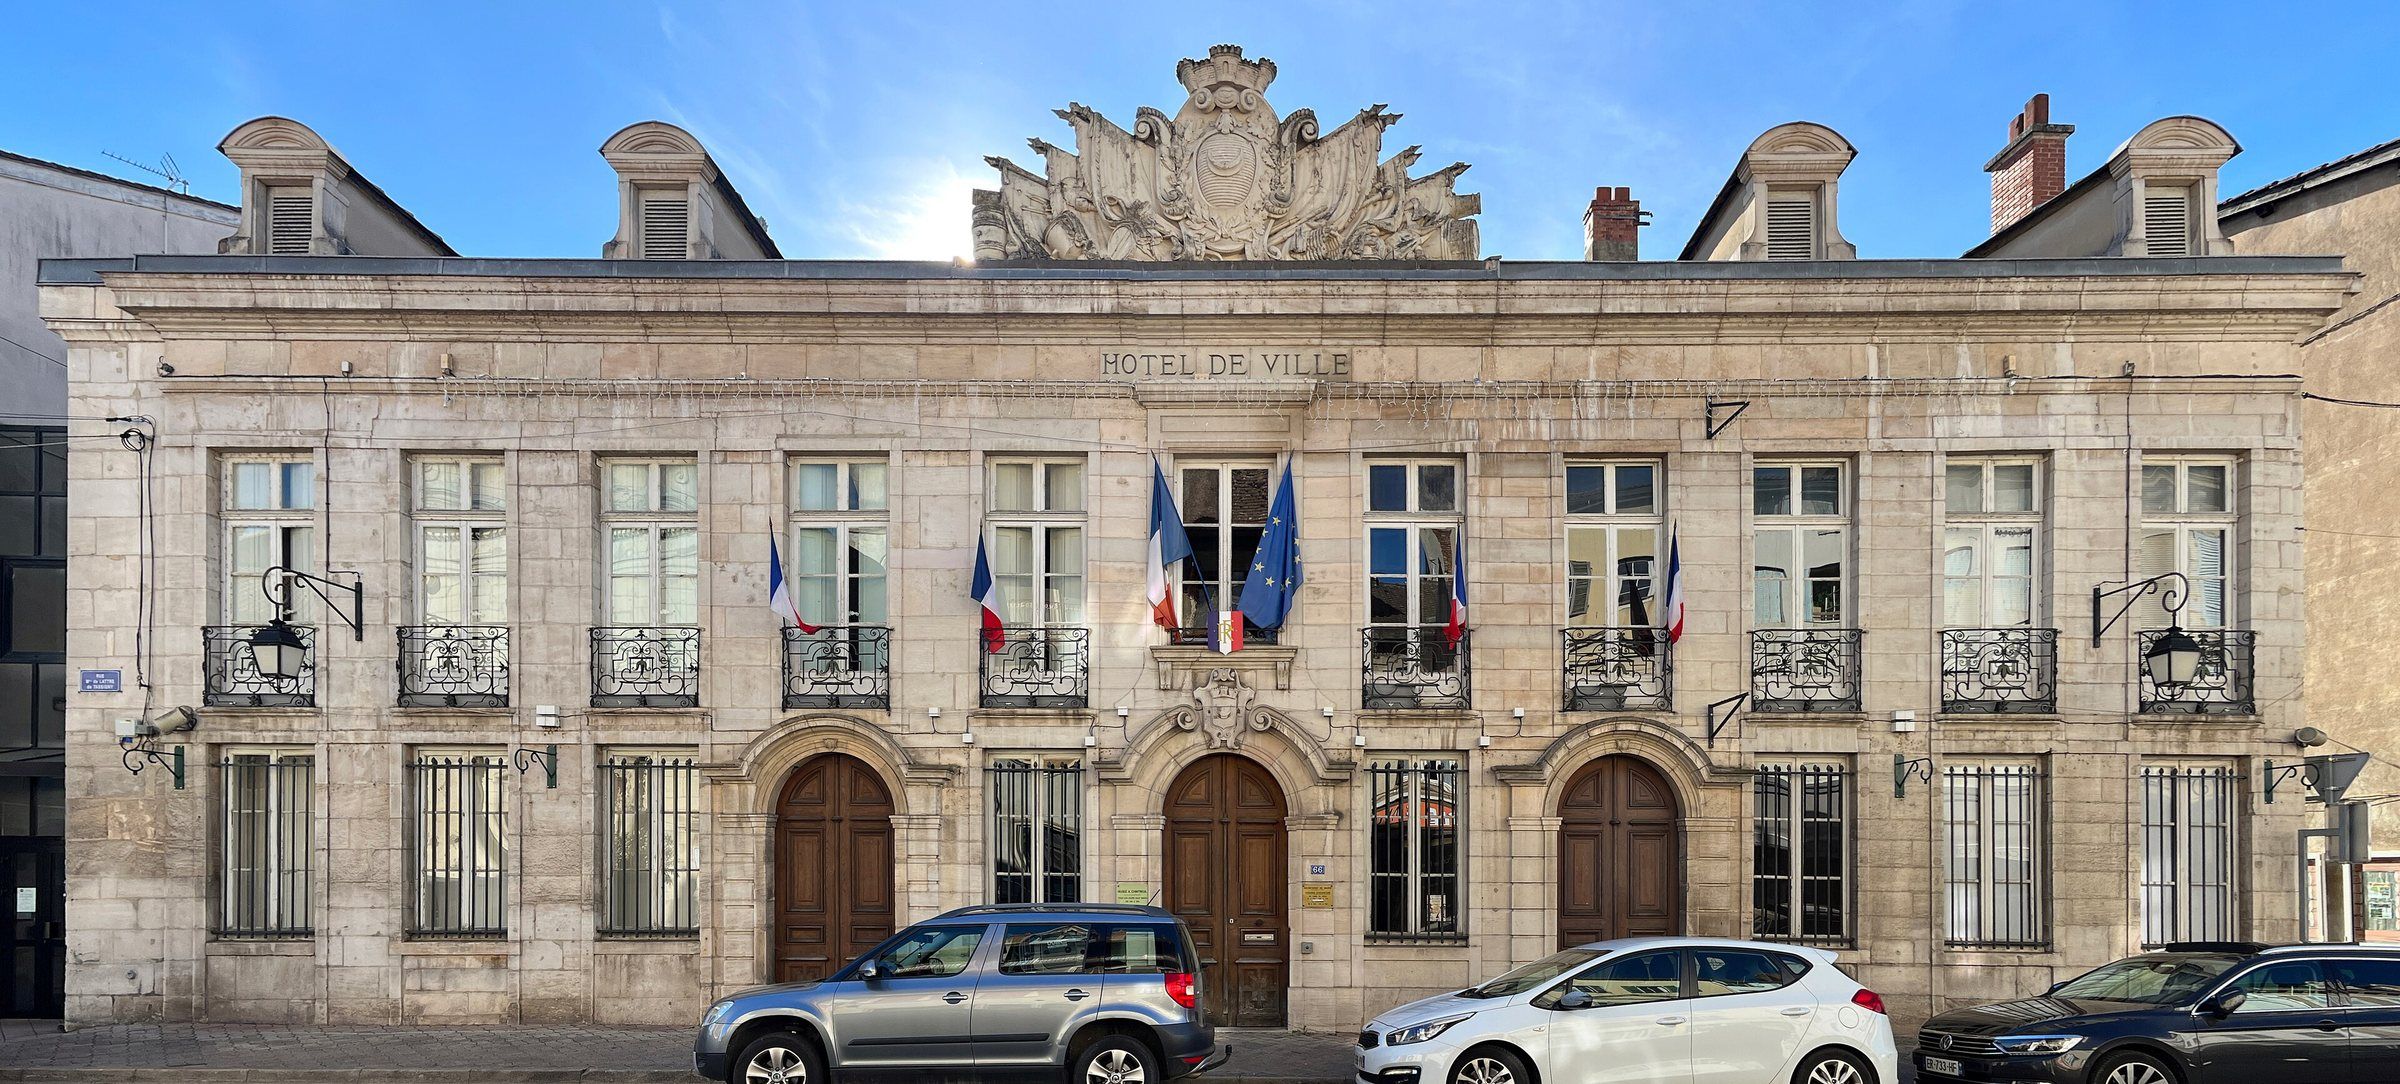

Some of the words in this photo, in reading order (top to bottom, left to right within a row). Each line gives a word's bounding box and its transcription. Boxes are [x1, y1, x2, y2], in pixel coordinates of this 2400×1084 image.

[1102, 353, 1195, 376] HOTEL
[1208, 354, 1248, 376] DE
[1261, 353, 1349, 376] VILLE
[1312, 866, 1323, 874] 66
